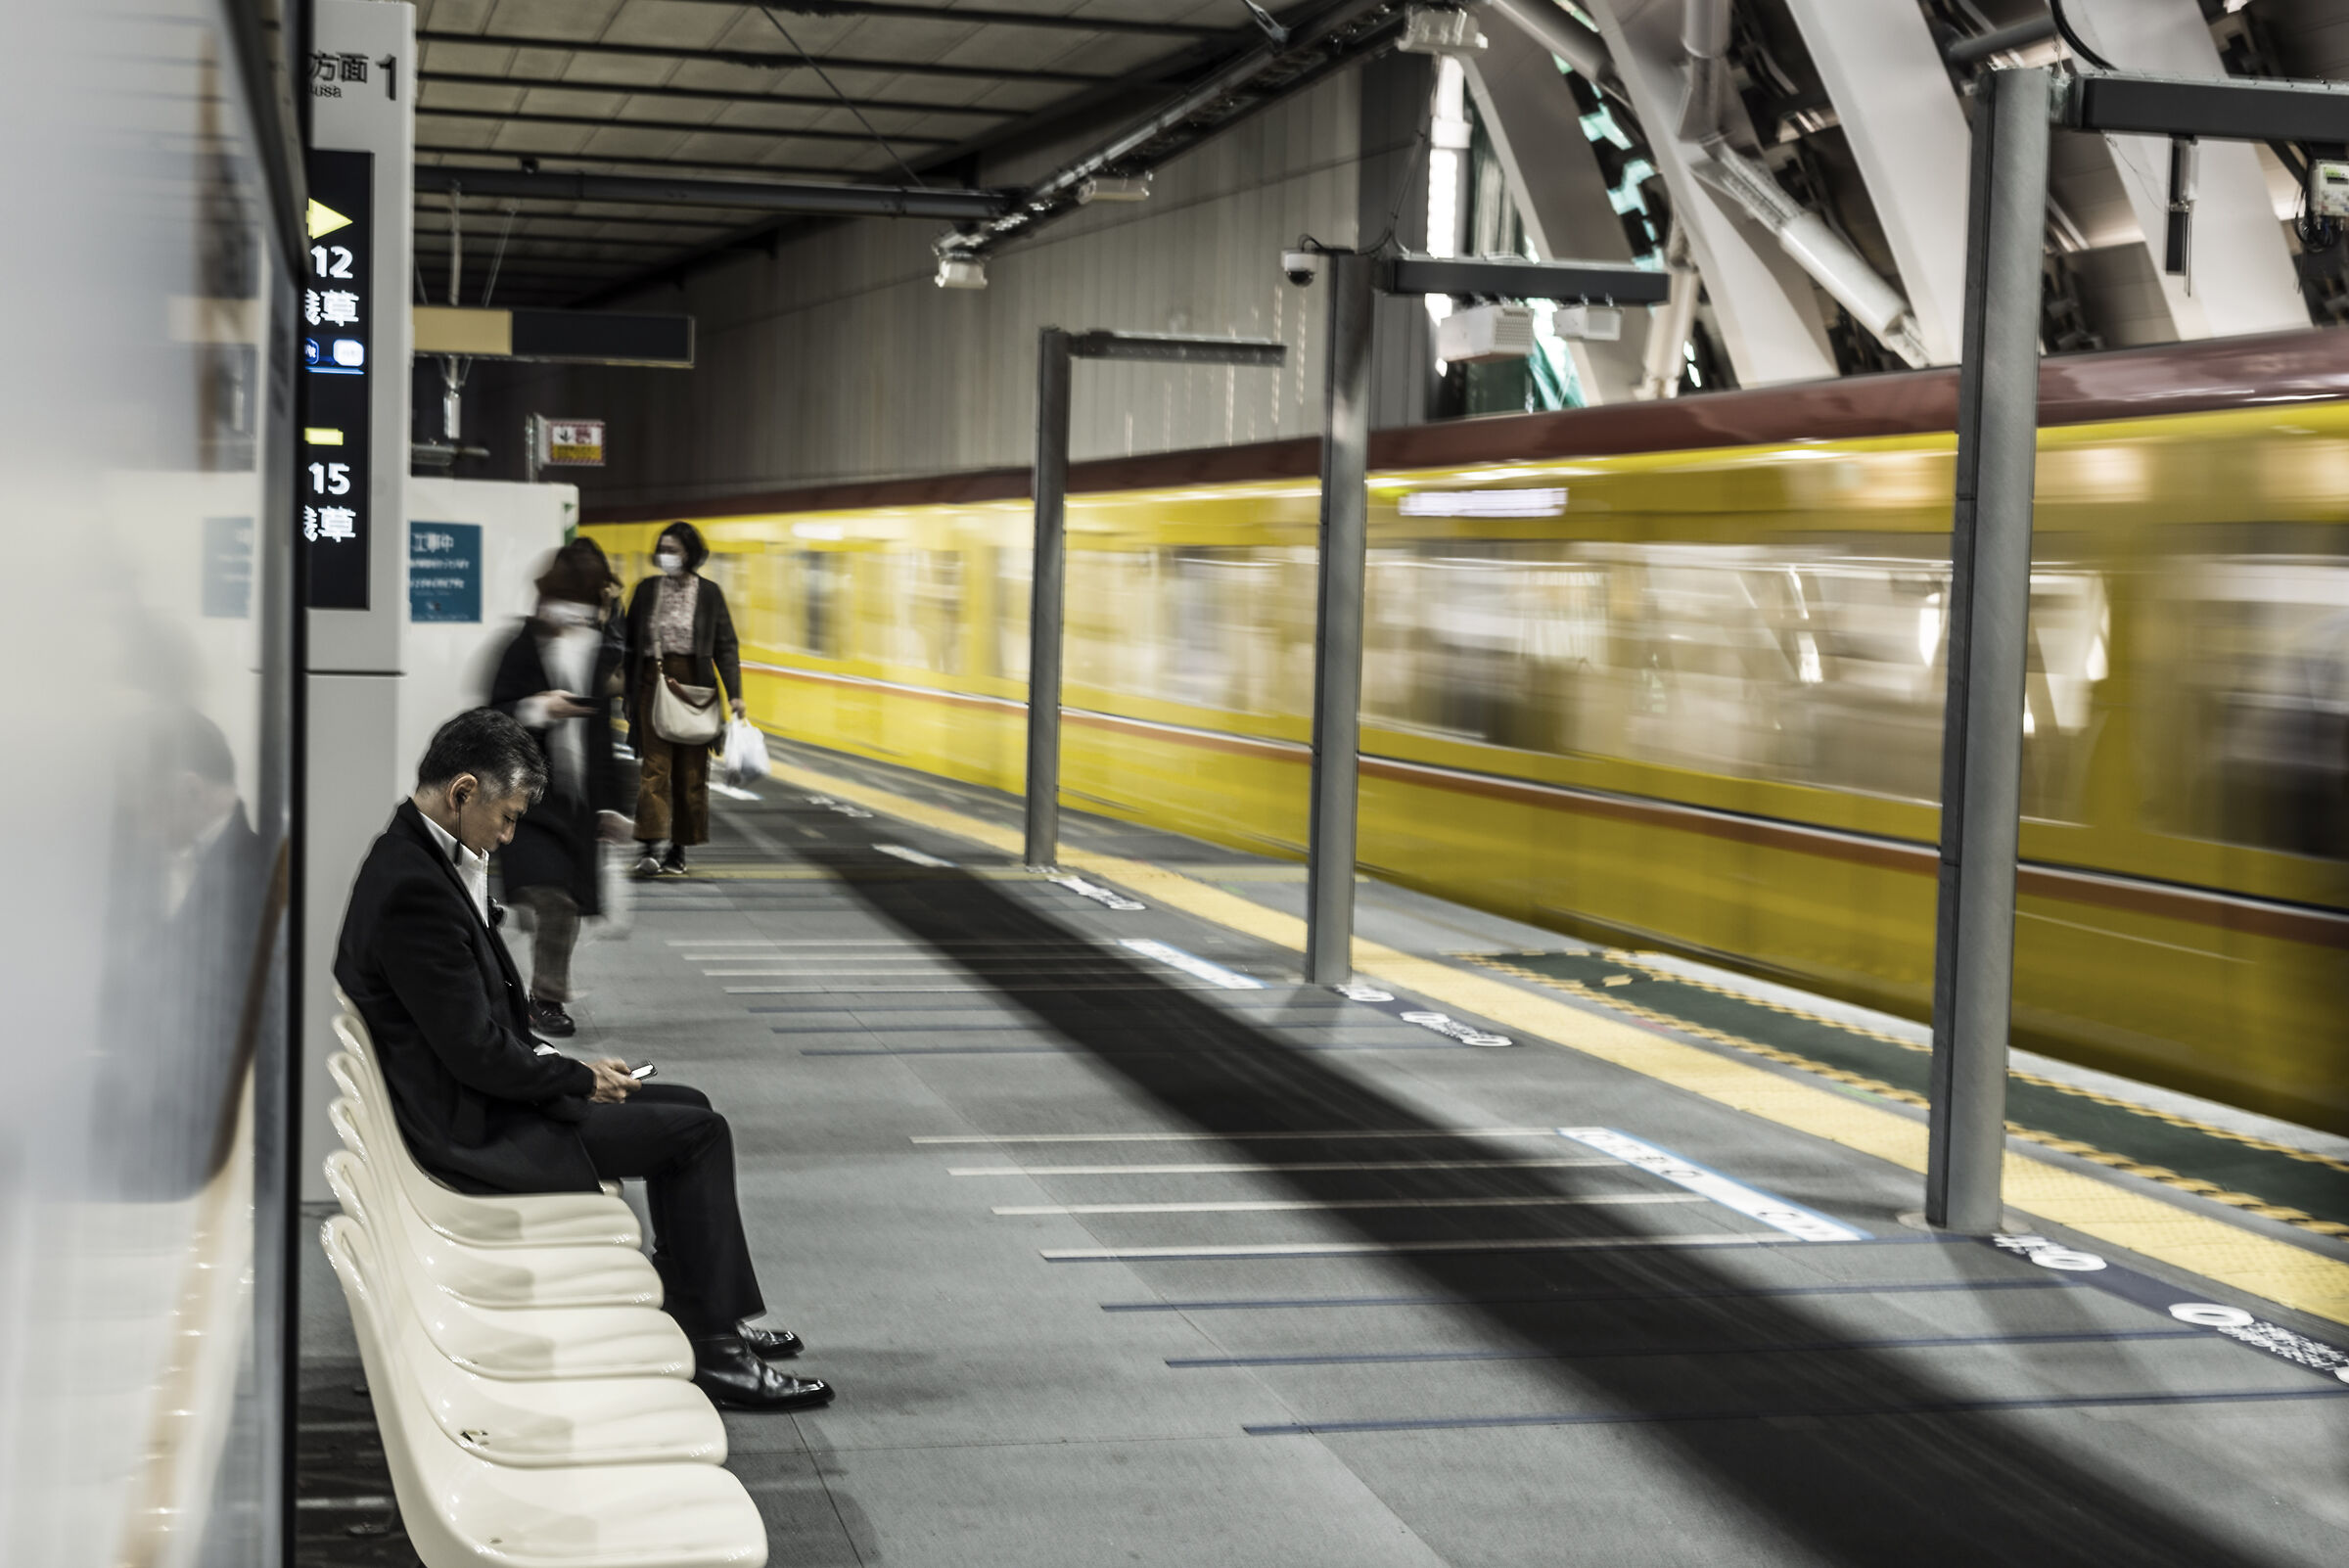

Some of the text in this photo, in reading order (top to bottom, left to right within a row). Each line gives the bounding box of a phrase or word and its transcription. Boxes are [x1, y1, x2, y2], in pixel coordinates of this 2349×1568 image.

[309, 50, 369, 84] 方面
[376, 54, 396, 101] 1
[309, 84, 343, 98] usa
[310, 245, 353, 279] 12
[308, 461, 351, 495] 15
